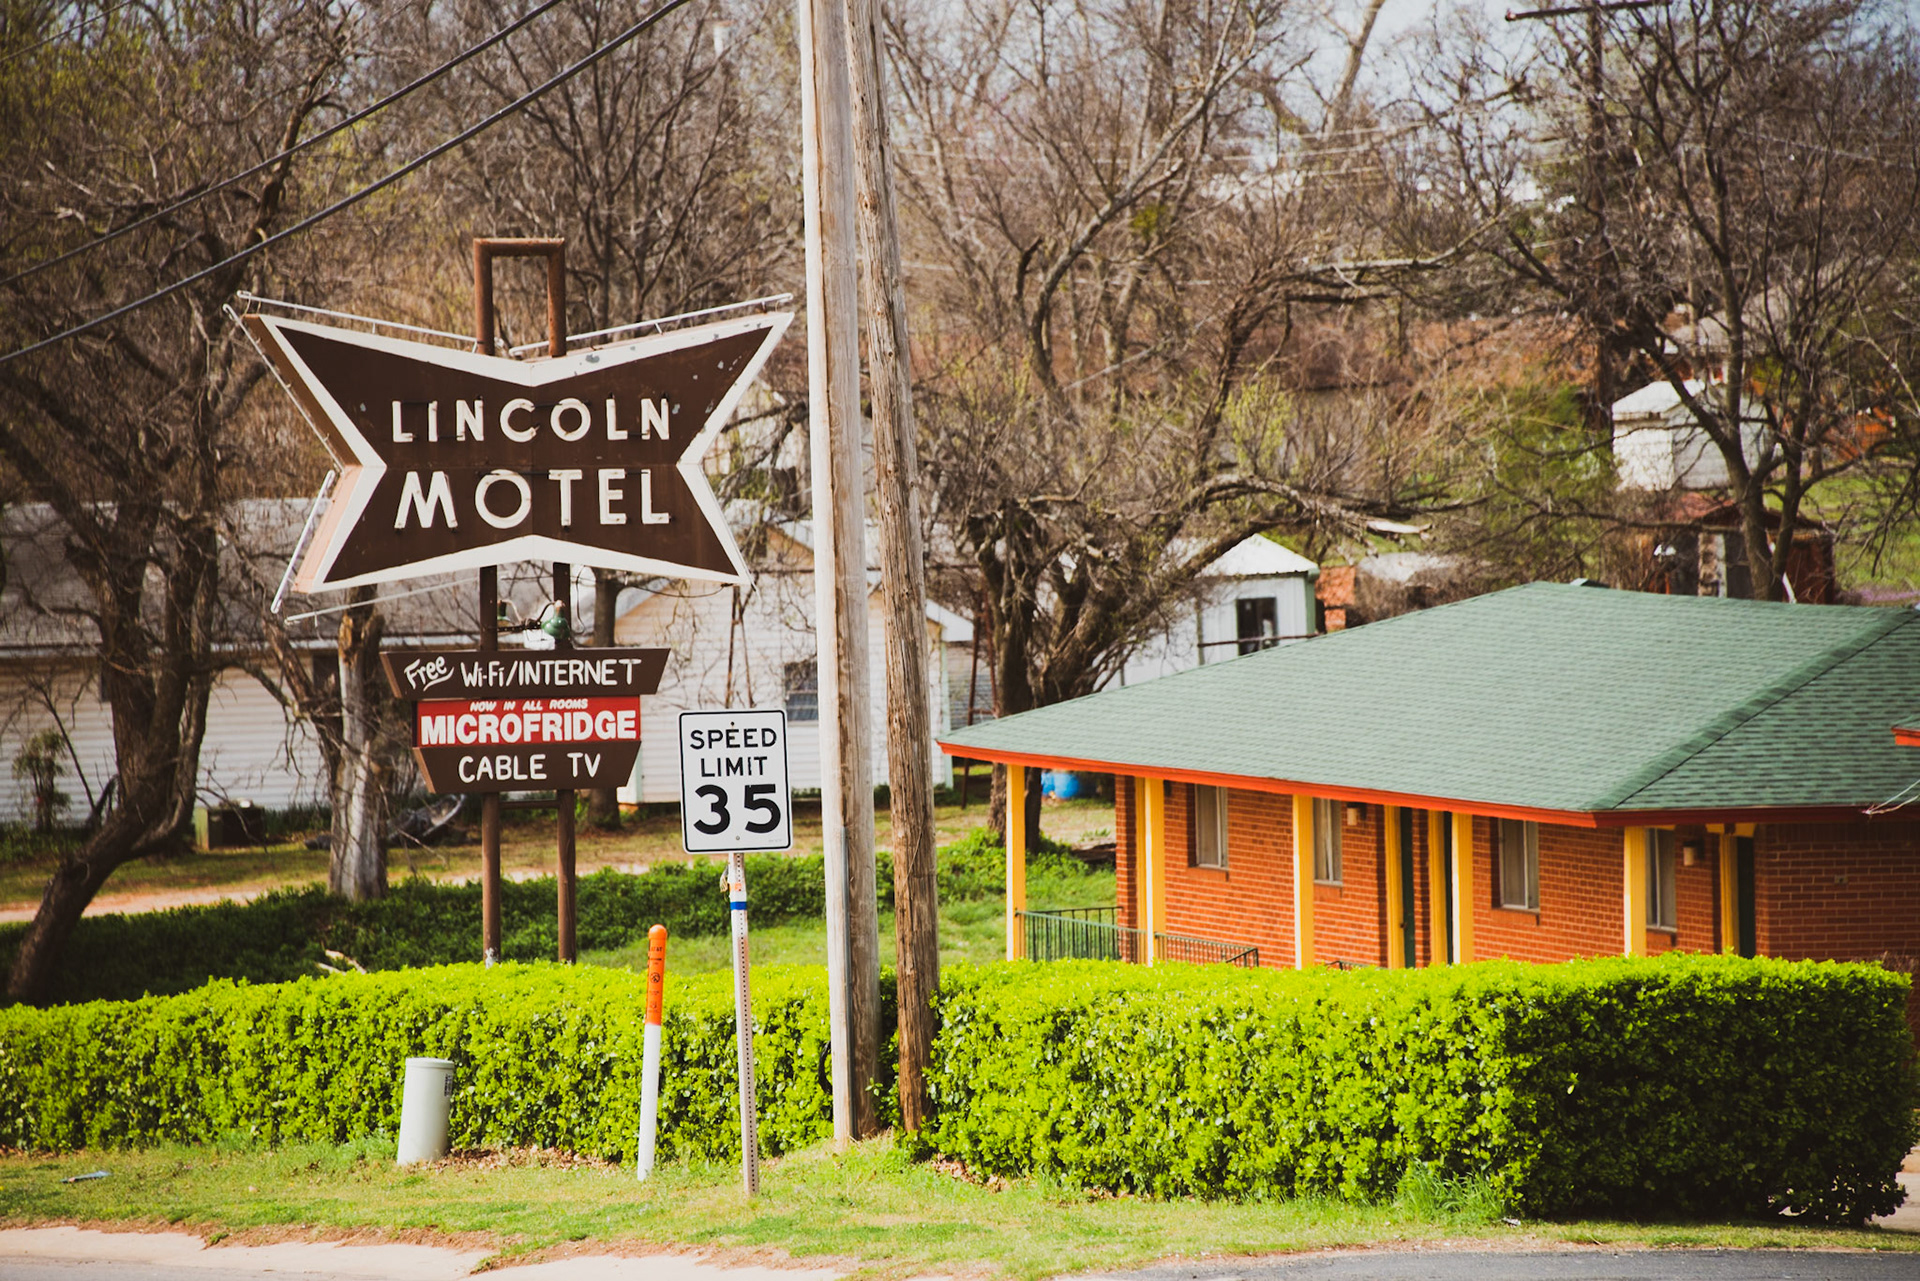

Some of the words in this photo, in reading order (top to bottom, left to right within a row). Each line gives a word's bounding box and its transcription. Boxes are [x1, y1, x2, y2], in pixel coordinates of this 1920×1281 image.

[392, 397, 670, 443] LINCOLN
[393, 468, 670, 529] MOTEL
[404, 656, 450, 690] Free
[460, 658, 642, 688] Wi-Fi/INTERNET
[470, 701, 496, 712] NOW
[503, 700, 516, 711] IN
[522, 700, 543, 711] ALL
[549, 698, 588, 710] ROOMS
[420, 711, 636, 745] MICROFRIDGE
[690, 728, 777, 750] SPEED
[458, 753, 547, 783] CABLE
[567, 752, 601, 778] TV
[701, 756, 768, 777] LIMIT
[693, 784, 781, 835] 35
